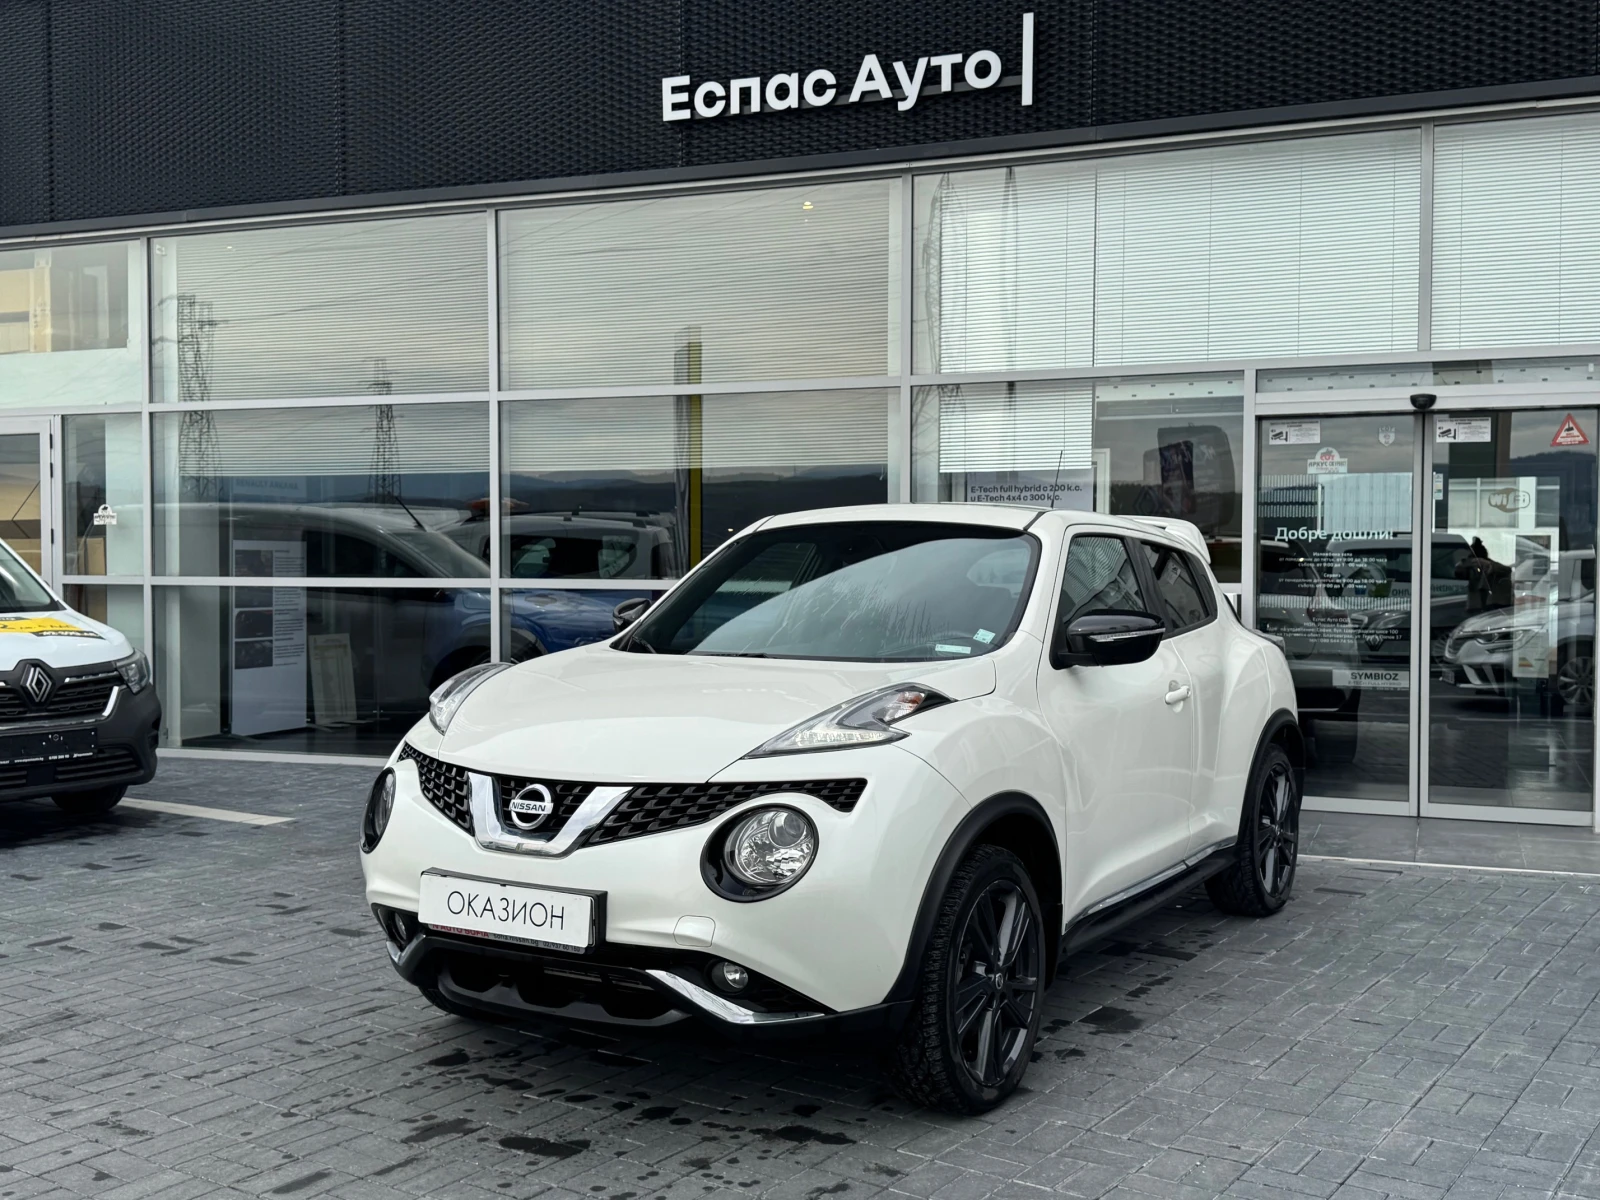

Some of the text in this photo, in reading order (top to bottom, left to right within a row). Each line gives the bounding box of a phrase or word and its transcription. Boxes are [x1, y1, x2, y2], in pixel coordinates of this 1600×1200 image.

[661, 49, 1002, 121] Еспас Ауто
[970, 485, 998, 493] E-Tech
[999, 485, 1013, 493] full
[1014, 484, 1041, 495] hybrid
[1049, 484, 1066, 492] 200
[977, 494, 1004, 502] E-Tech
[1029, 493, 1046, 501] 300
[1275, 526, 1394, 542] Добре дошли!
[1351, 672, 1399, 681] SYMBIOZ
[511, 801, 547, 812] NISSAN
[447, 890, 565, 930] ОКАЗИОН
